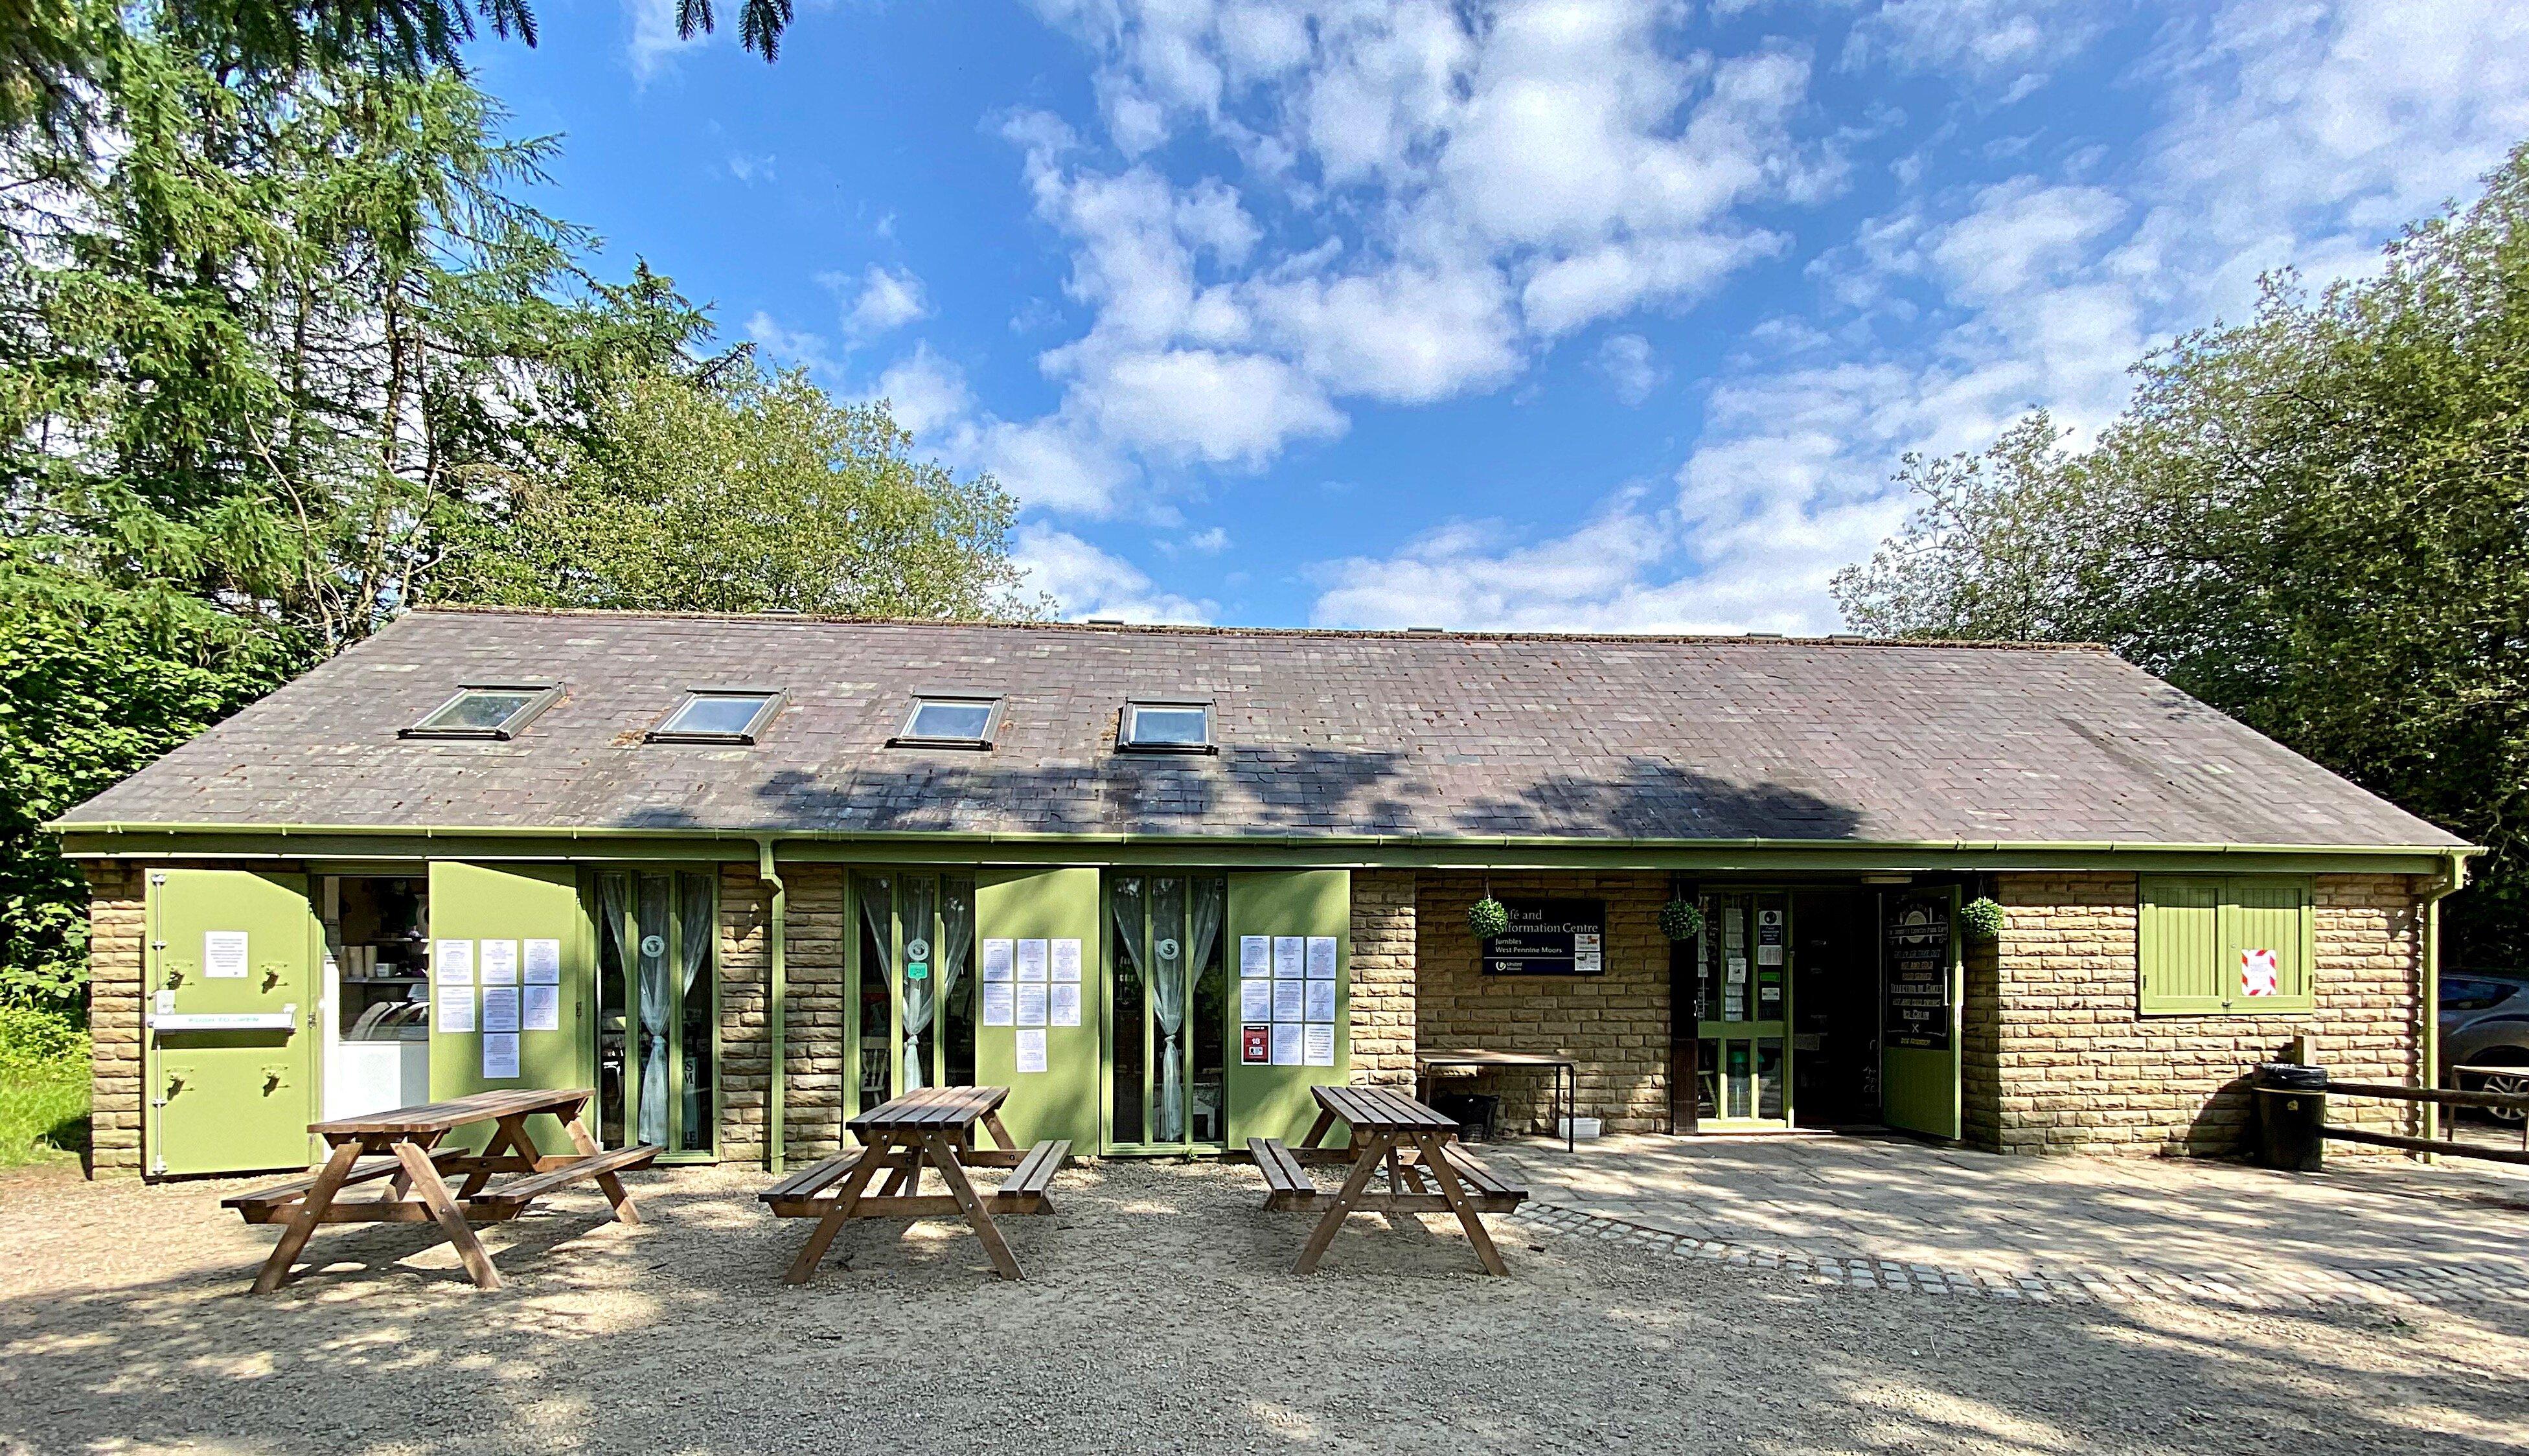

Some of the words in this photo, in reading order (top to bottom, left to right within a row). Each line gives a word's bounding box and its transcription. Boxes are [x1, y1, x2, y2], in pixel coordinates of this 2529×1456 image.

[1522, 909, 1542, 920] and
[1505, 922, 1560, 933] formation
[1562, 923, 1598, 933] Centre
